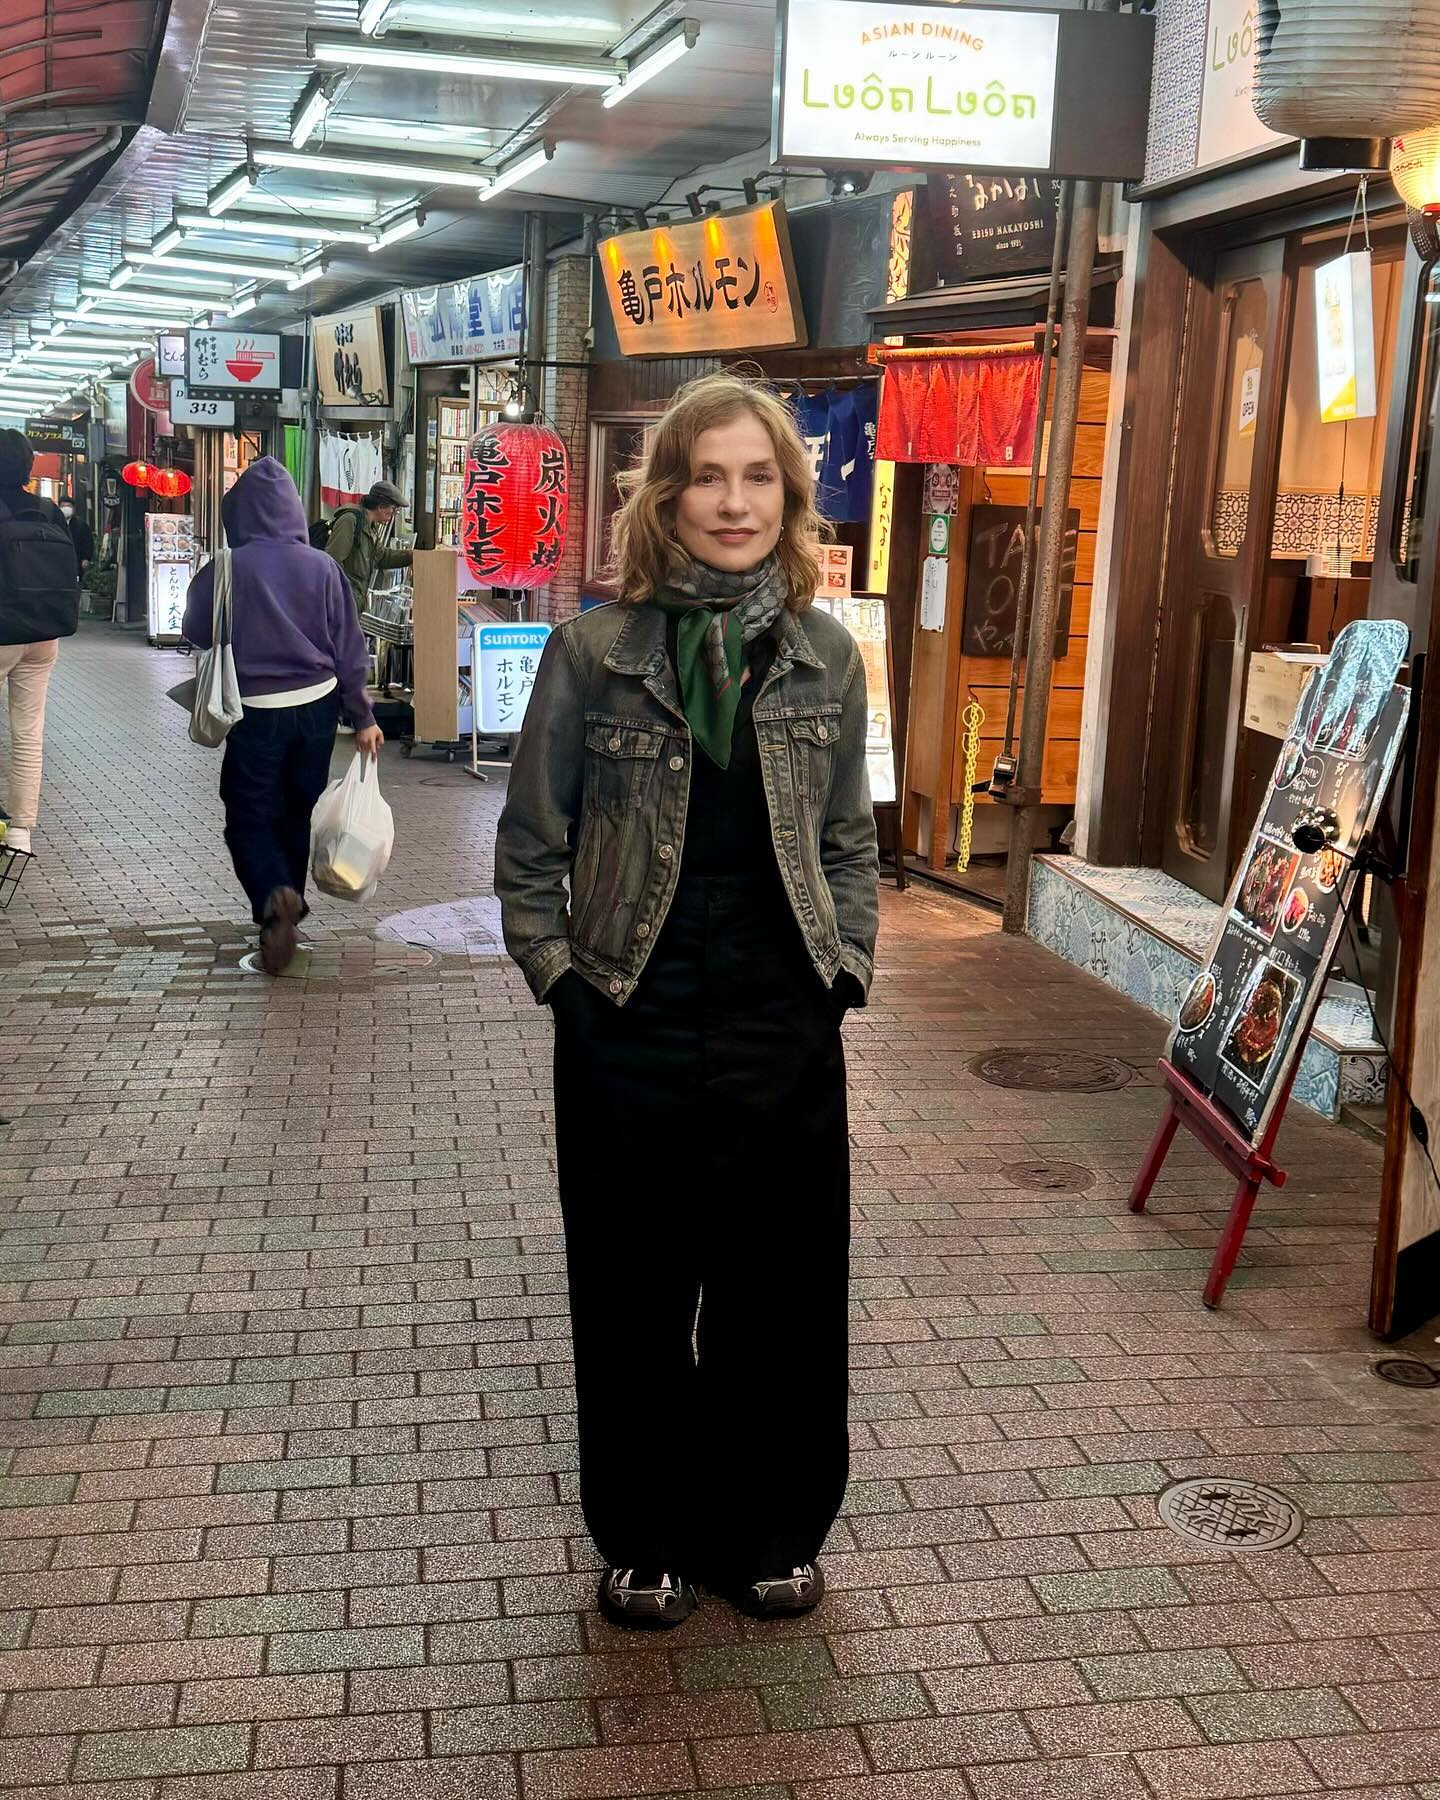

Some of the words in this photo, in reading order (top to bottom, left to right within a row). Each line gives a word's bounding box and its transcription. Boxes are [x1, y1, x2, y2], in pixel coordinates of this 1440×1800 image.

[859, 22, 915, 47] ASIAN
[920, 22, 985, 52] DINING
[888, 49, 921, 61] ルーン
[925, 52, 959, 63] ルーン
[1212, 9, 1253, 71] Luô
[854, 132, 889, 145] Always
[892, 134, 929, 148] Serving
[931, 135, 982, 148] Happiness
[972, 227, 994, 240] EBISU
[997, 218, 1045, 236] NAKAYOSHI
[617, 254, 761, 325] 亀戸ホルモン
[194, 337, 209, 380] 竹むら
[189, 402, 218, 415] 313
[464, 433, 511, 577] 亀戸ホルモン
[530, 448, 568, 571] 炭火焼
[483, 633, 546, 646] SUNTORY
[496, 658, 515, 723] ホルモン
[518, 655, 537, 696] 亀戸
